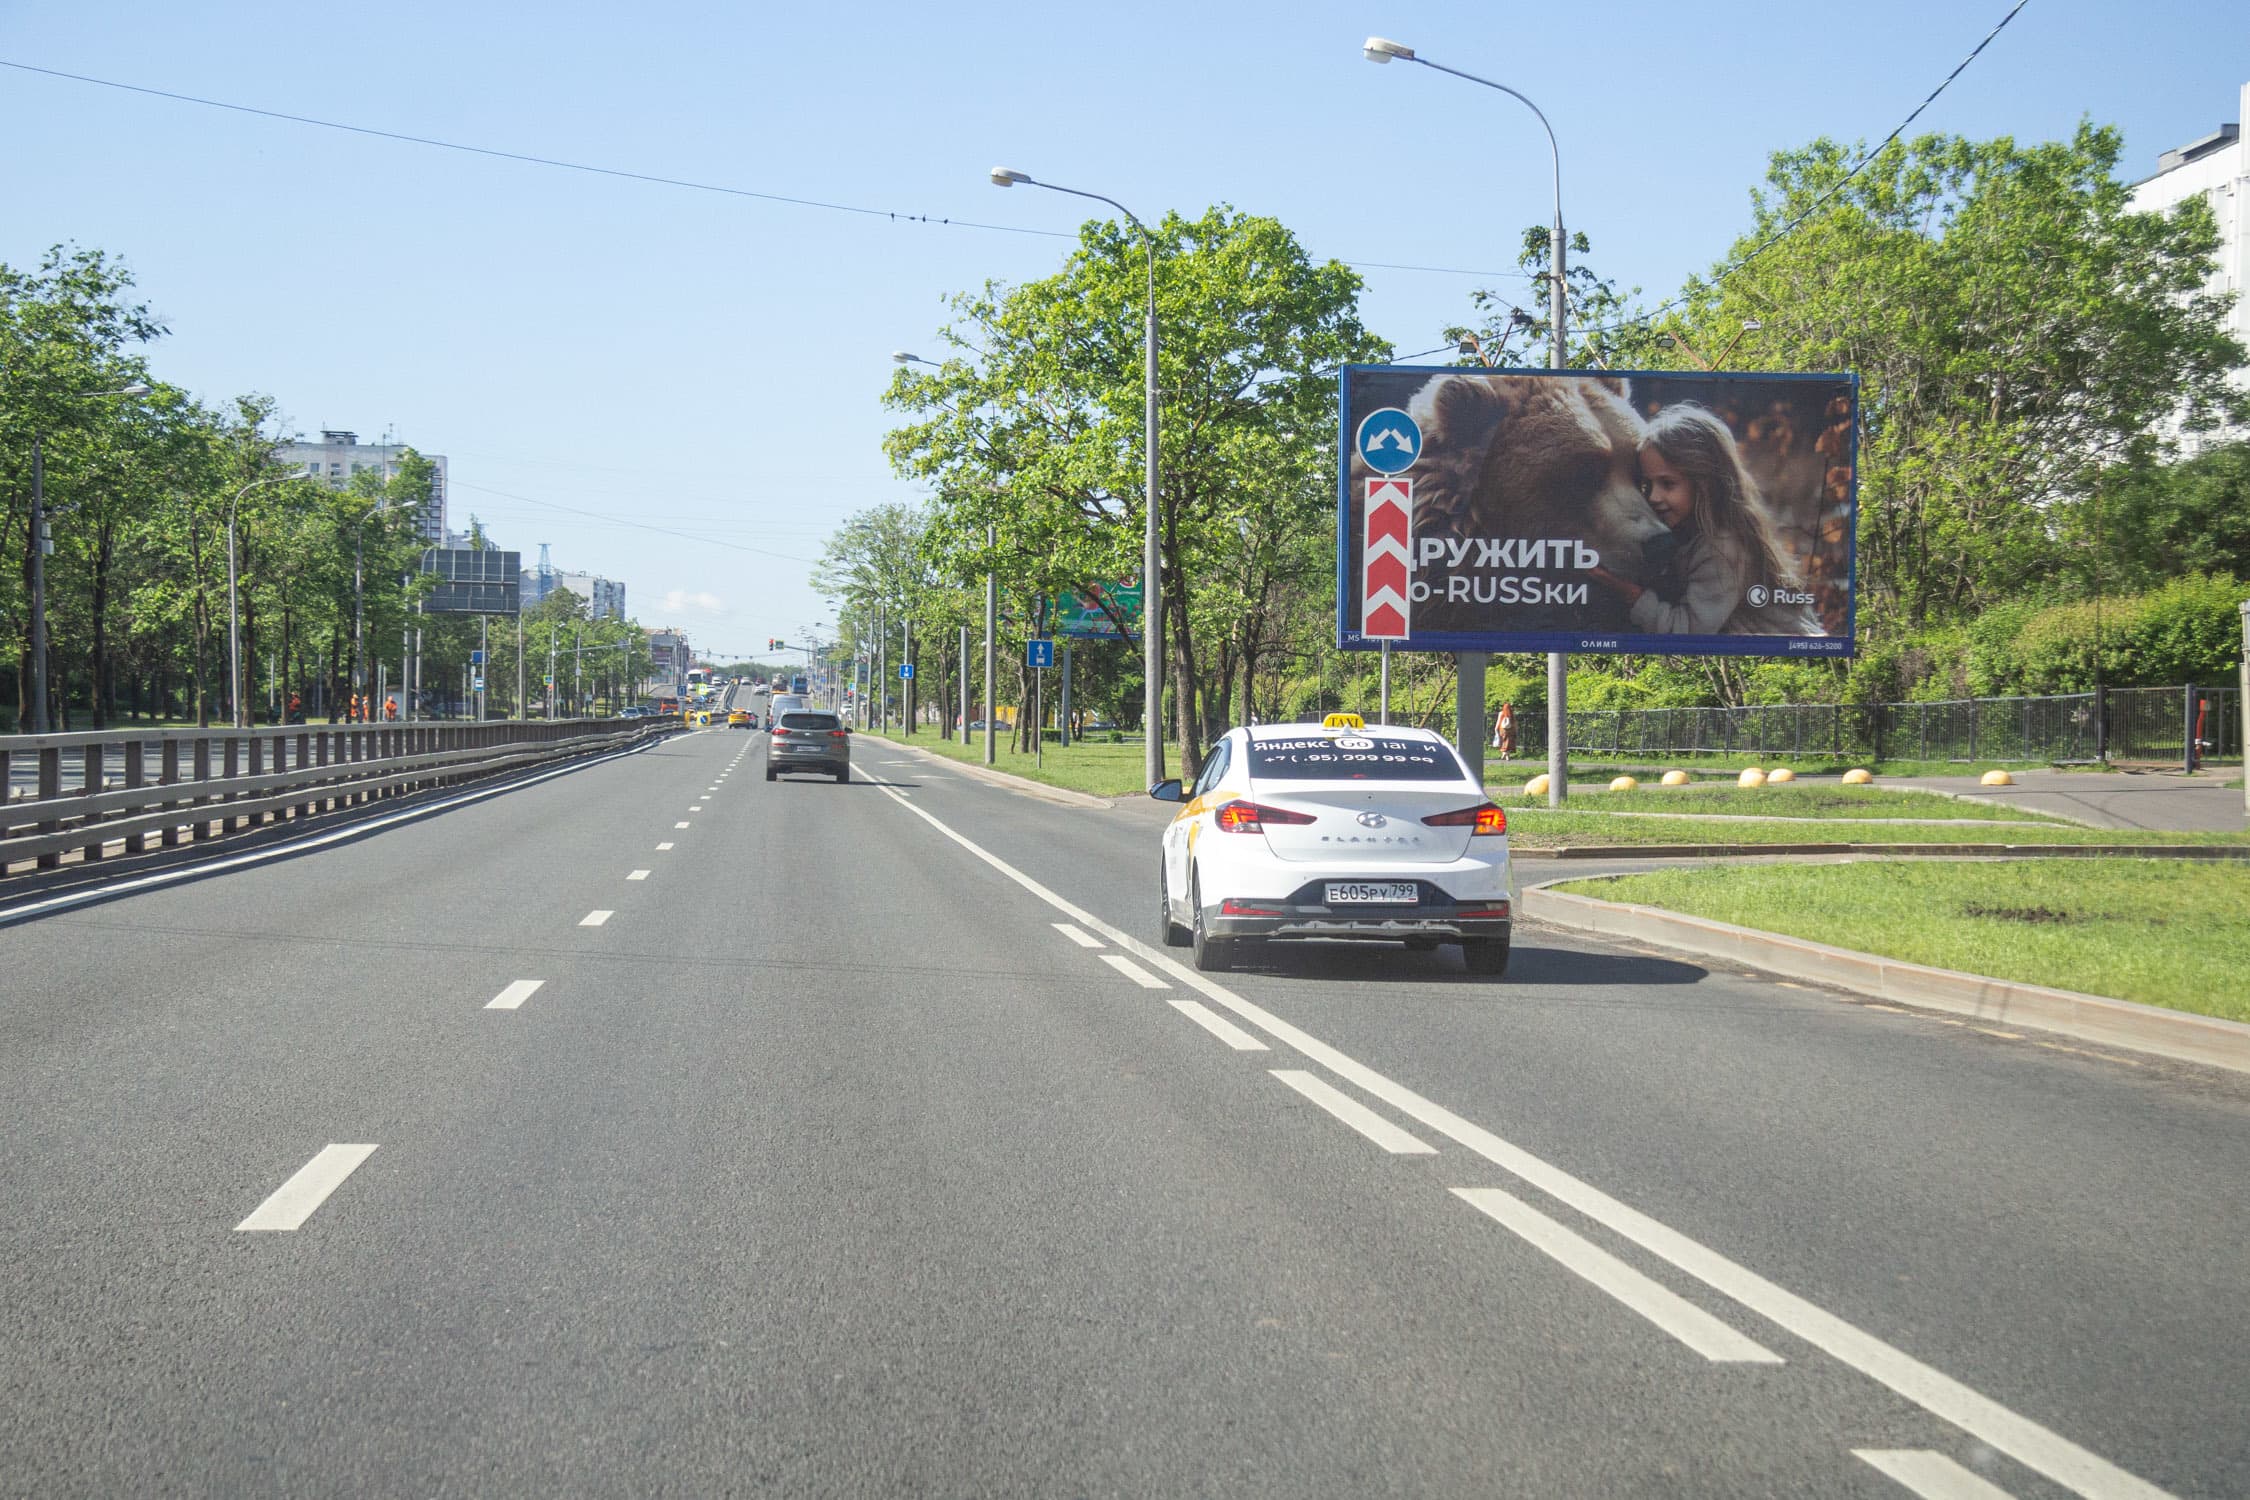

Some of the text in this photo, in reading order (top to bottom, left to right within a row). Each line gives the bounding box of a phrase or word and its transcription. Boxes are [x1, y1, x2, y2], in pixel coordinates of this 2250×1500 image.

[1409, 576, 1588, 605] о-RUSSки
[1773, 589, 1815, 604] Russ
[1581, 640, 1617, 648] ОЛИМП
[1330, 717, 1358, 728] TAXI
[1254, 740, 1330, 751] Яндекс
[1341, 739, 1369, 748] Go
[1291, 754, 1338, 763] (95)
[1391, 884, 1413, 896] 799
